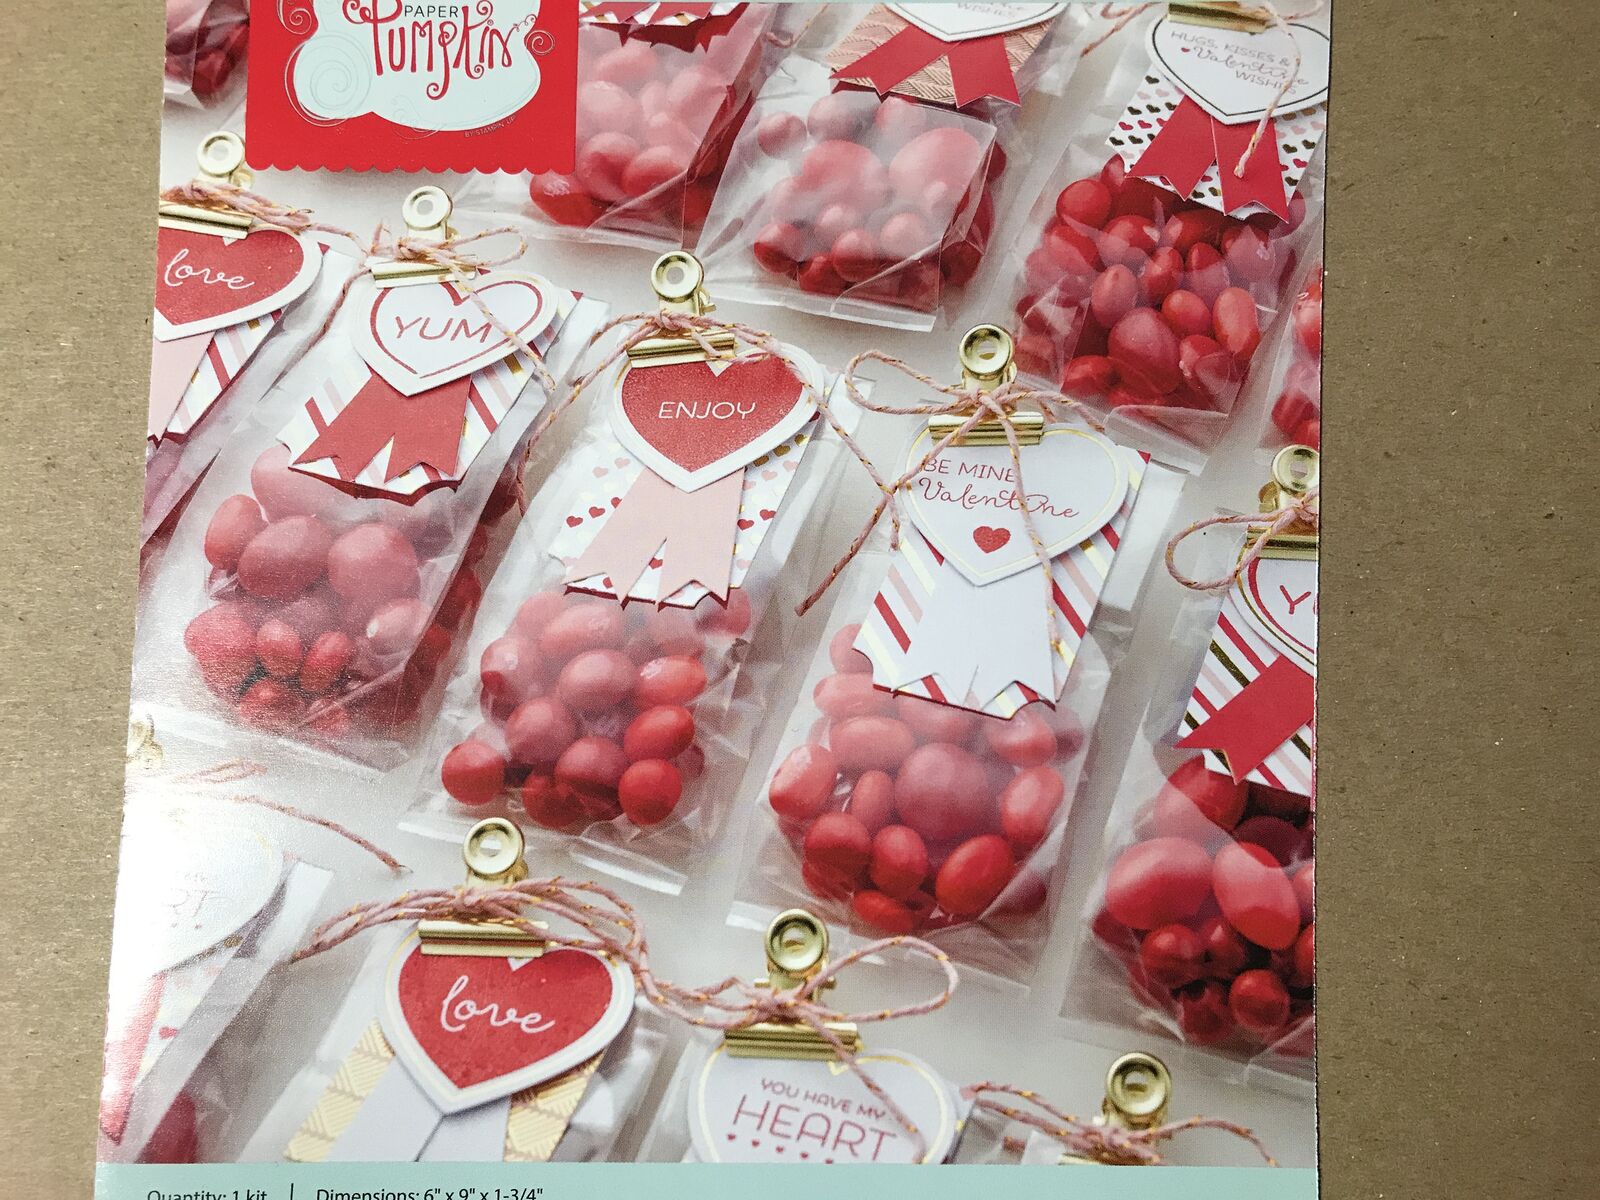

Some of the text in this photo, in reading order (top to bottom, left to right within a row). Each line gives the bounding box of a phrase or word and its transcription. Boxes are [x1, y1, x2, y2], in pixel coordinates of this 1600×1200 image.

[403, 5, 459, 18] PAPER
[1170, 31, 1218, 48] HUGS,
[1224, 44, 1275, 63] KISSES
[1235, 69, 1296, 95] WISHS
[164, 248, 255, 290] love
[394, 314, 494, 344] YUM
[658, 401, 756, 419] ENJOY
[921, 458, 1016, 483] BE MINE
[1280, 585, 1317, 615] Y
[440, 975, 556, 1033] love
[761, 1078, 887, 1120] YOU HAVE MY
[732, 1094, 898, 1162] HEART
[232, 1190, 240, 1200] 1
[246, 1189, 267, 1200] kit
[316, 1188, 543, 1200] Dimensions: 6" x 9" x 1-3/4"
